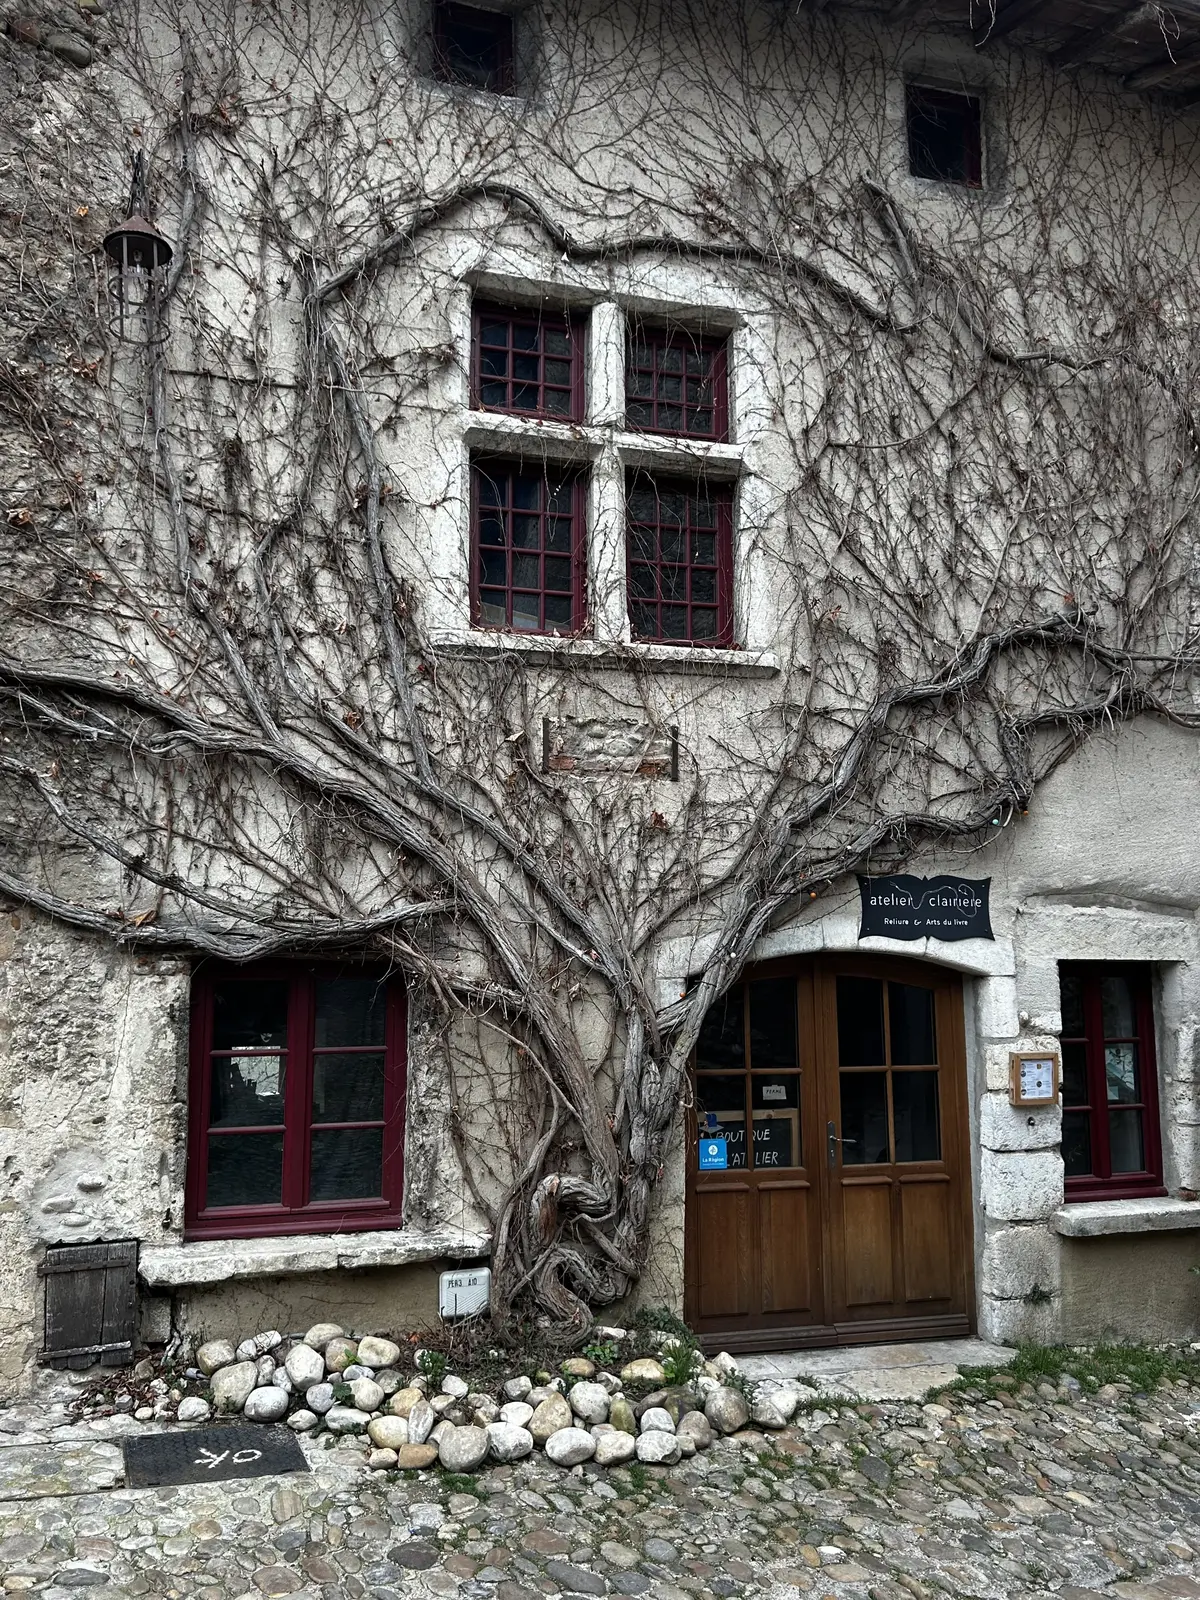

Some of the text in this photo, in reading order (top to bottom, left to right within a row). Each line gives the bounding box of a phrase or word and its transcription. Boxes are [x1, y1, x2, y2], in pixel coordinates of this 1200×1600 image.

[870, 893, 912, 906] atelier
[884, 917, 909, 925] Reliure
[926, 918, 941, 926] Arts
[943, 918, 952, 926] du
[954, 918, 969, 926] livre
